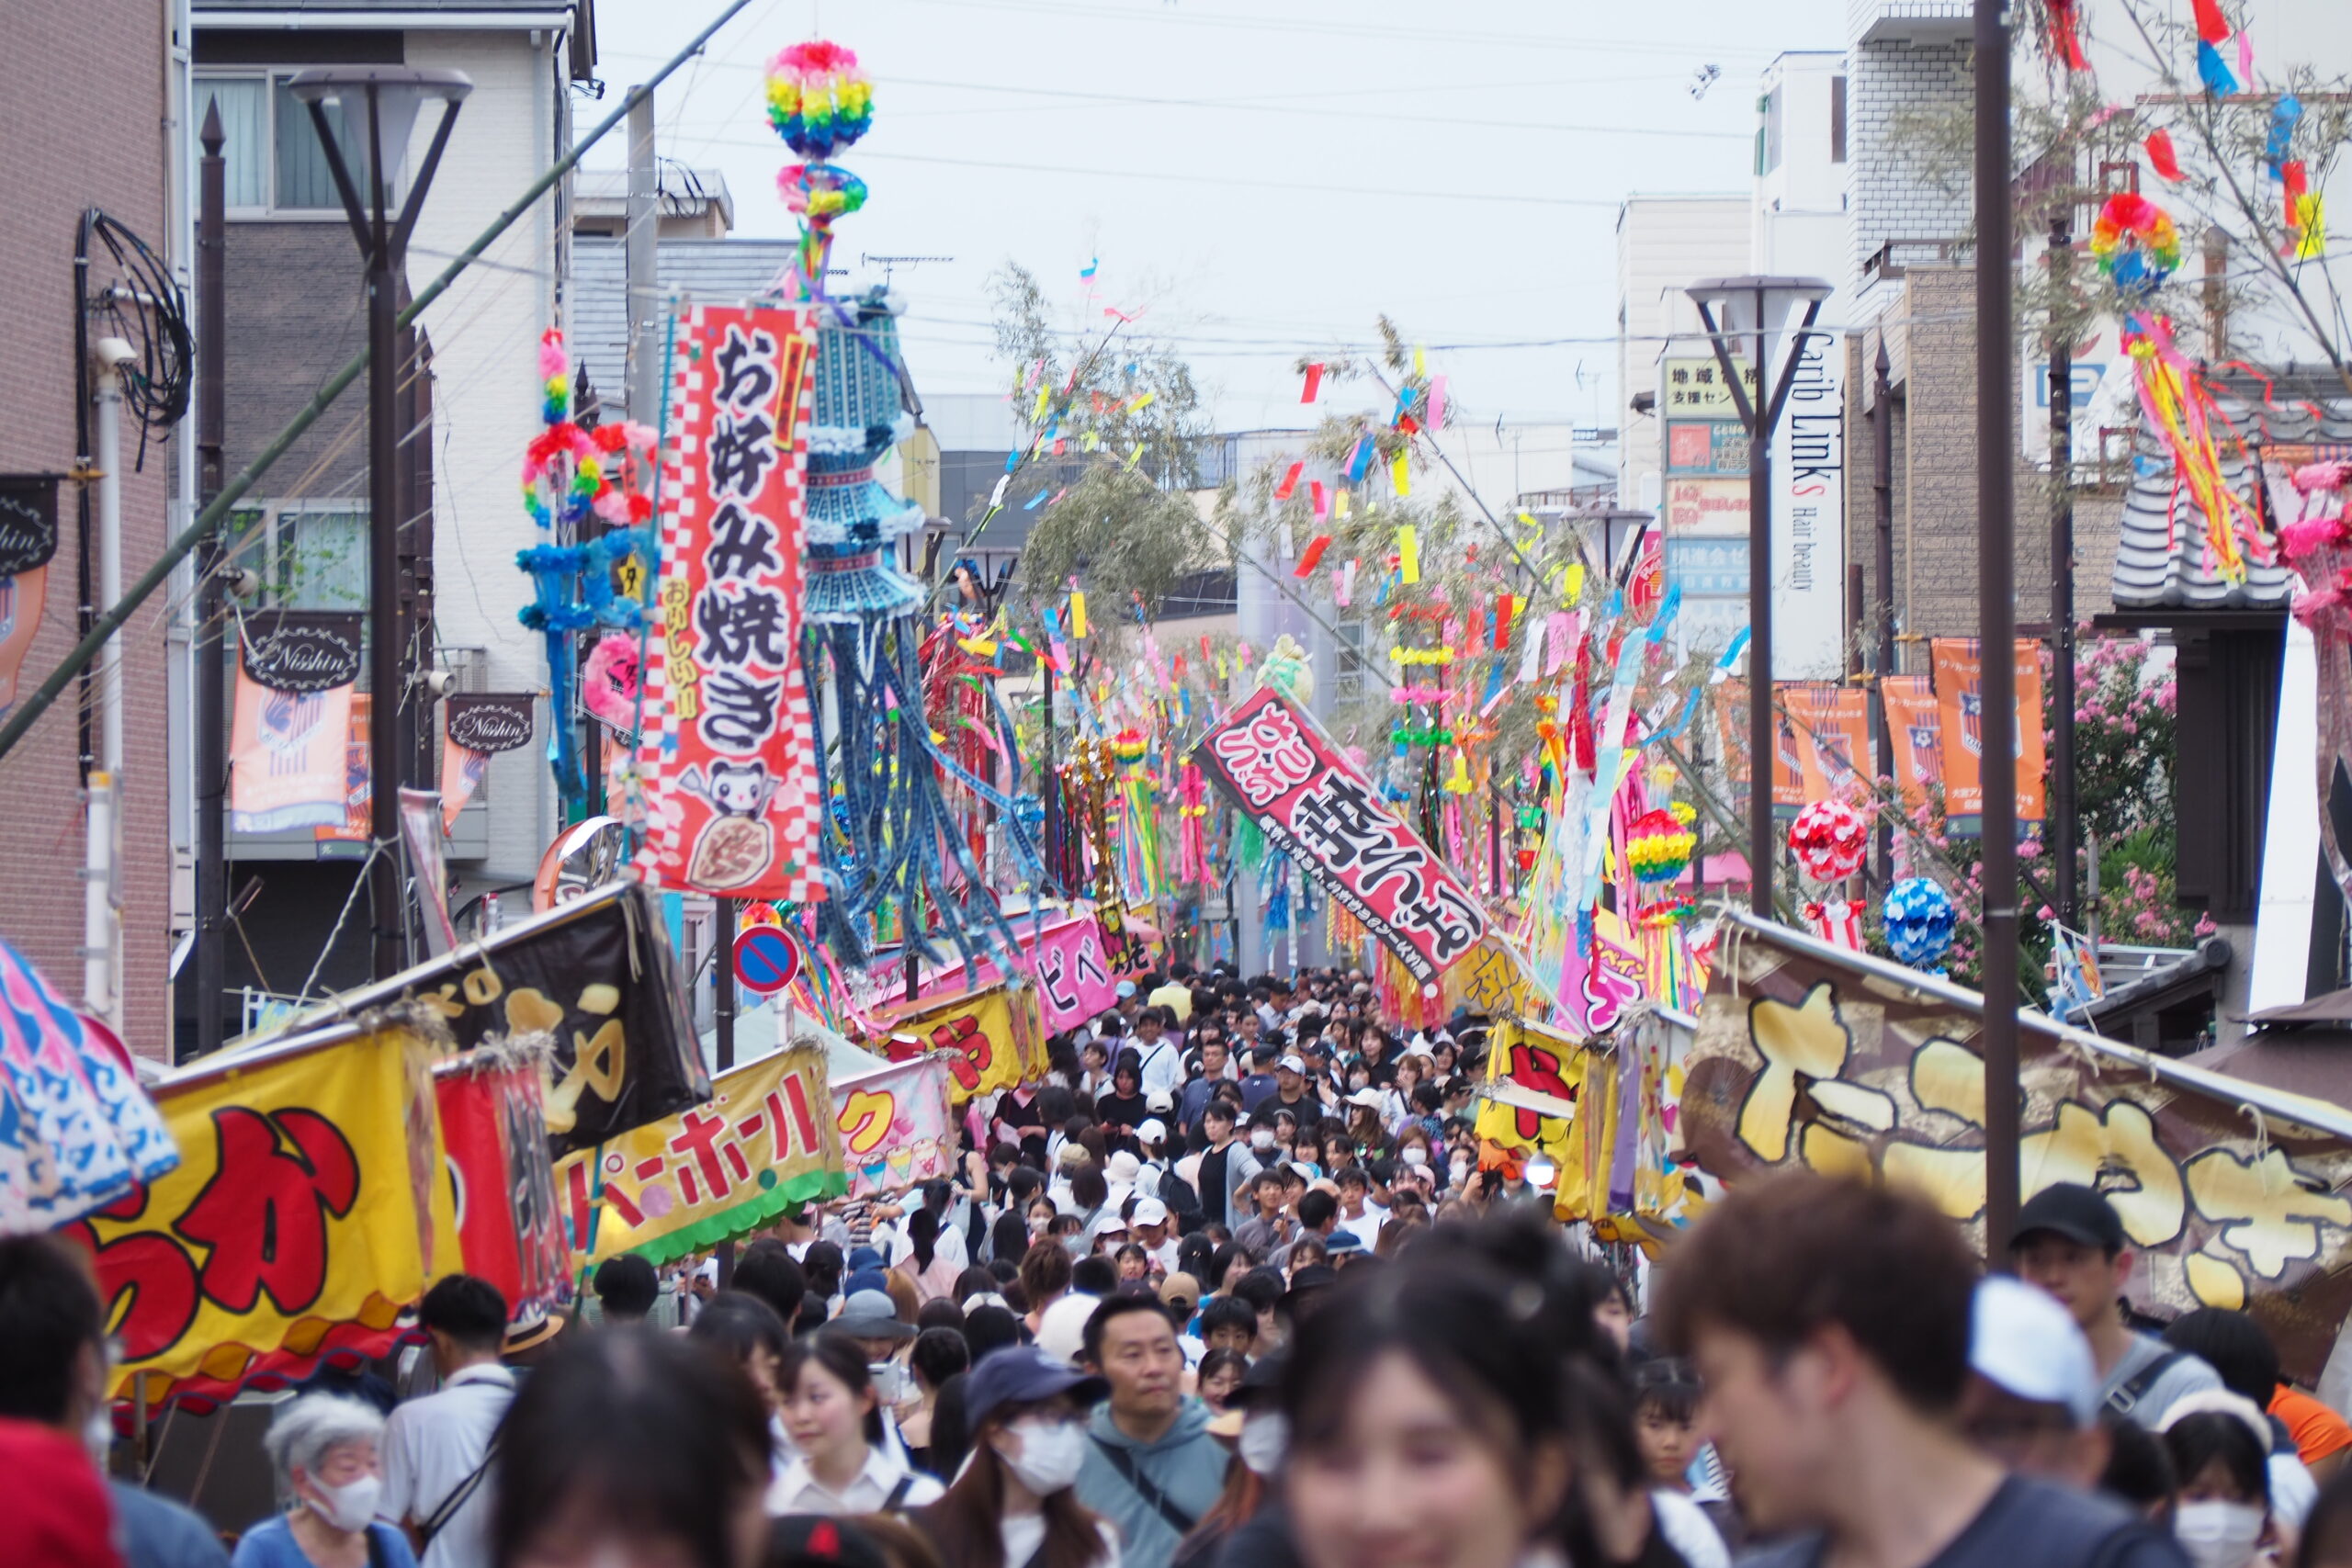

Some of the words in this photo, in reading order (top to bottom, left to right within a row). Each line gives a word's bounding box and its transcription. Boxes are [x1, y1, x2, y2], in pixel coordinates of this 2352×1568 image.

[1672, 368, 1757, 385] 地域括
[1792, 414, 1841, 497] Links
[695, 327, 787, 751] お好み焼き
[265, 644, 345, 671] Nisshin
[463, 715, 522, 738] Nisshin
